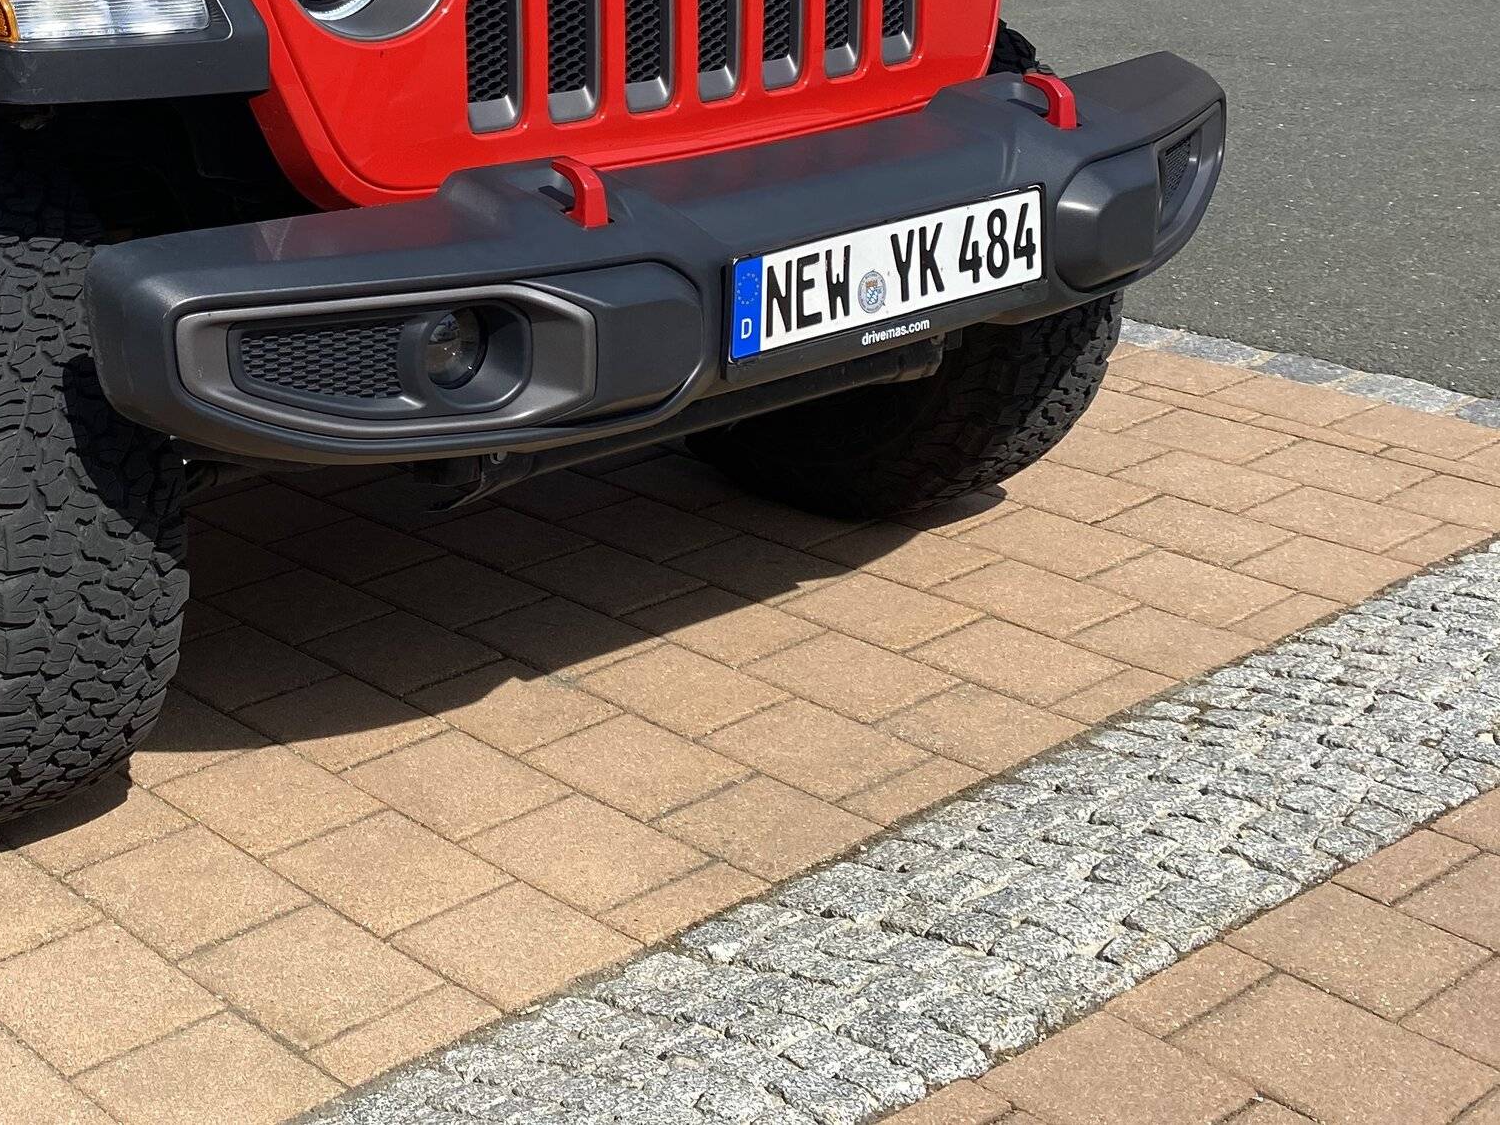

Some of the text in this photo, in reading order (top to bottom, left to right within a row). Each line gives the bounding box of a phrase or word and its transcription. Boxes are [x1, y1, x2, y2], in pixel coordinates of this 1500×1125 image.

[766, 245, 850, 337] NEW
[890, 222, 945, 302] YK
[959, 203, 1036, 283] 484
[741, 318, 752, 339] D
[861, 319, 930, 346] drivemas.com
